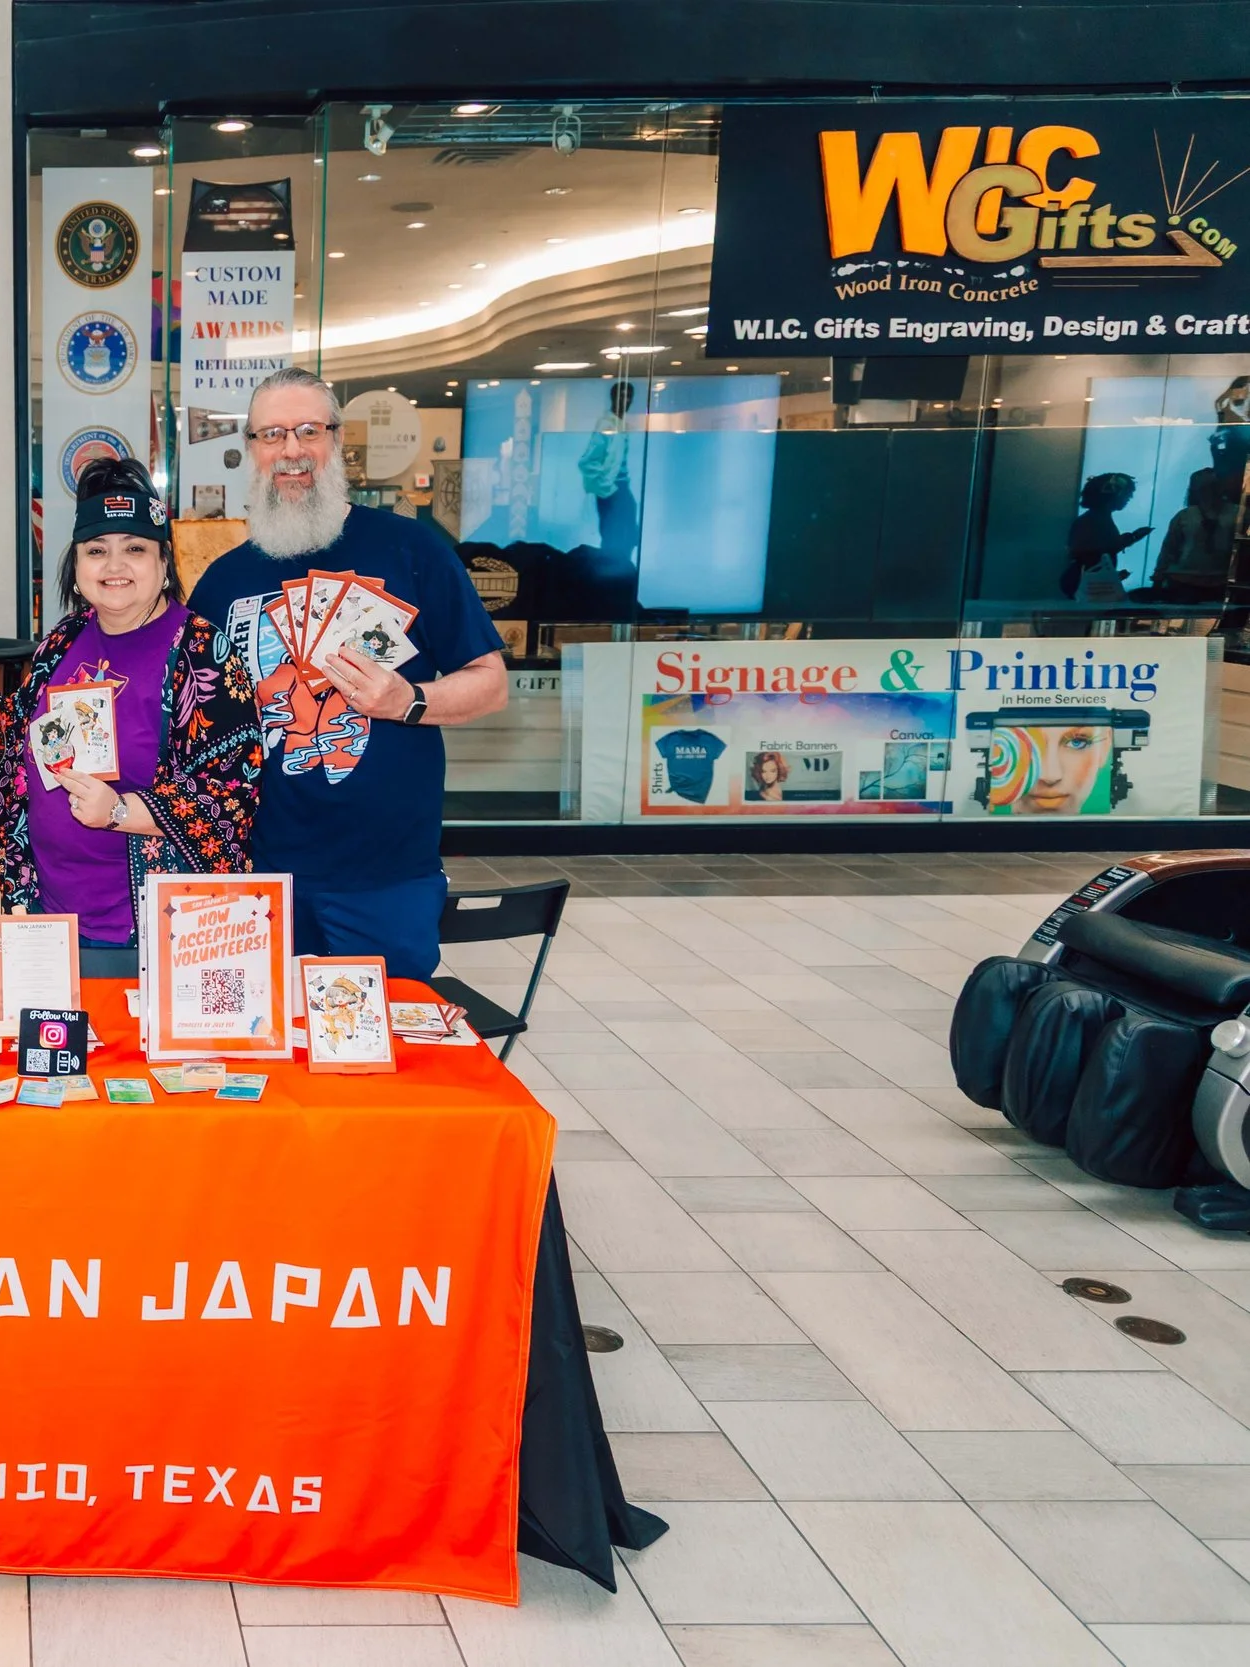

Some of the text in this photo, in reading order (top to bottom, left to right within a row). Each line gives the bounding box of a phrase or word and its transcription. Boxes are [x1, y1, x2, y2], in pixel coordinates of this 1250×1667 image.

[65, 207, 129, 233] UNITED STATES
[946, 164, 1156, 262] Gifts
[84, 274, 113, 283] ARMY
[195, 266, 281, 282] CUSTOM
[208, 290, 268, 305] MADE
[835, 274, 1039, 302] Wood Iron Concrete
[191, 320, 284, 339] AWARDS
[734, 314, 1250, 342] W.I.C. Gifts Engraving, Design & Craft
[195, 358, 286, 370] RETIREMENT
[195, 377, 258, 389] PLAQU
[64, 433, 97, 465] DEPARTMENT
[516, 677, 560, 690] GIFT
[655, 649, 1160, 706] Signage & Printing
[1002, 693, 1107, 705] In Home Services
[890, 729, 935, 741] Canvas
[675, 746, 707, 754] MAMA
[760, 741, 838, 750] Fabric Banners
[651, 762, 663, 794] Shirts
[197, 907, 230, 928] NOW
[178, 919, 257, 950] ACCEPTING
[173, 933, 268, 968] VOLUNTEERS!
[29, 1010, 79, 1021] Follow Us!
[141, 1260, 451, 1328] JAPAN
[124, 1463, 322, 1513] TEXAS
